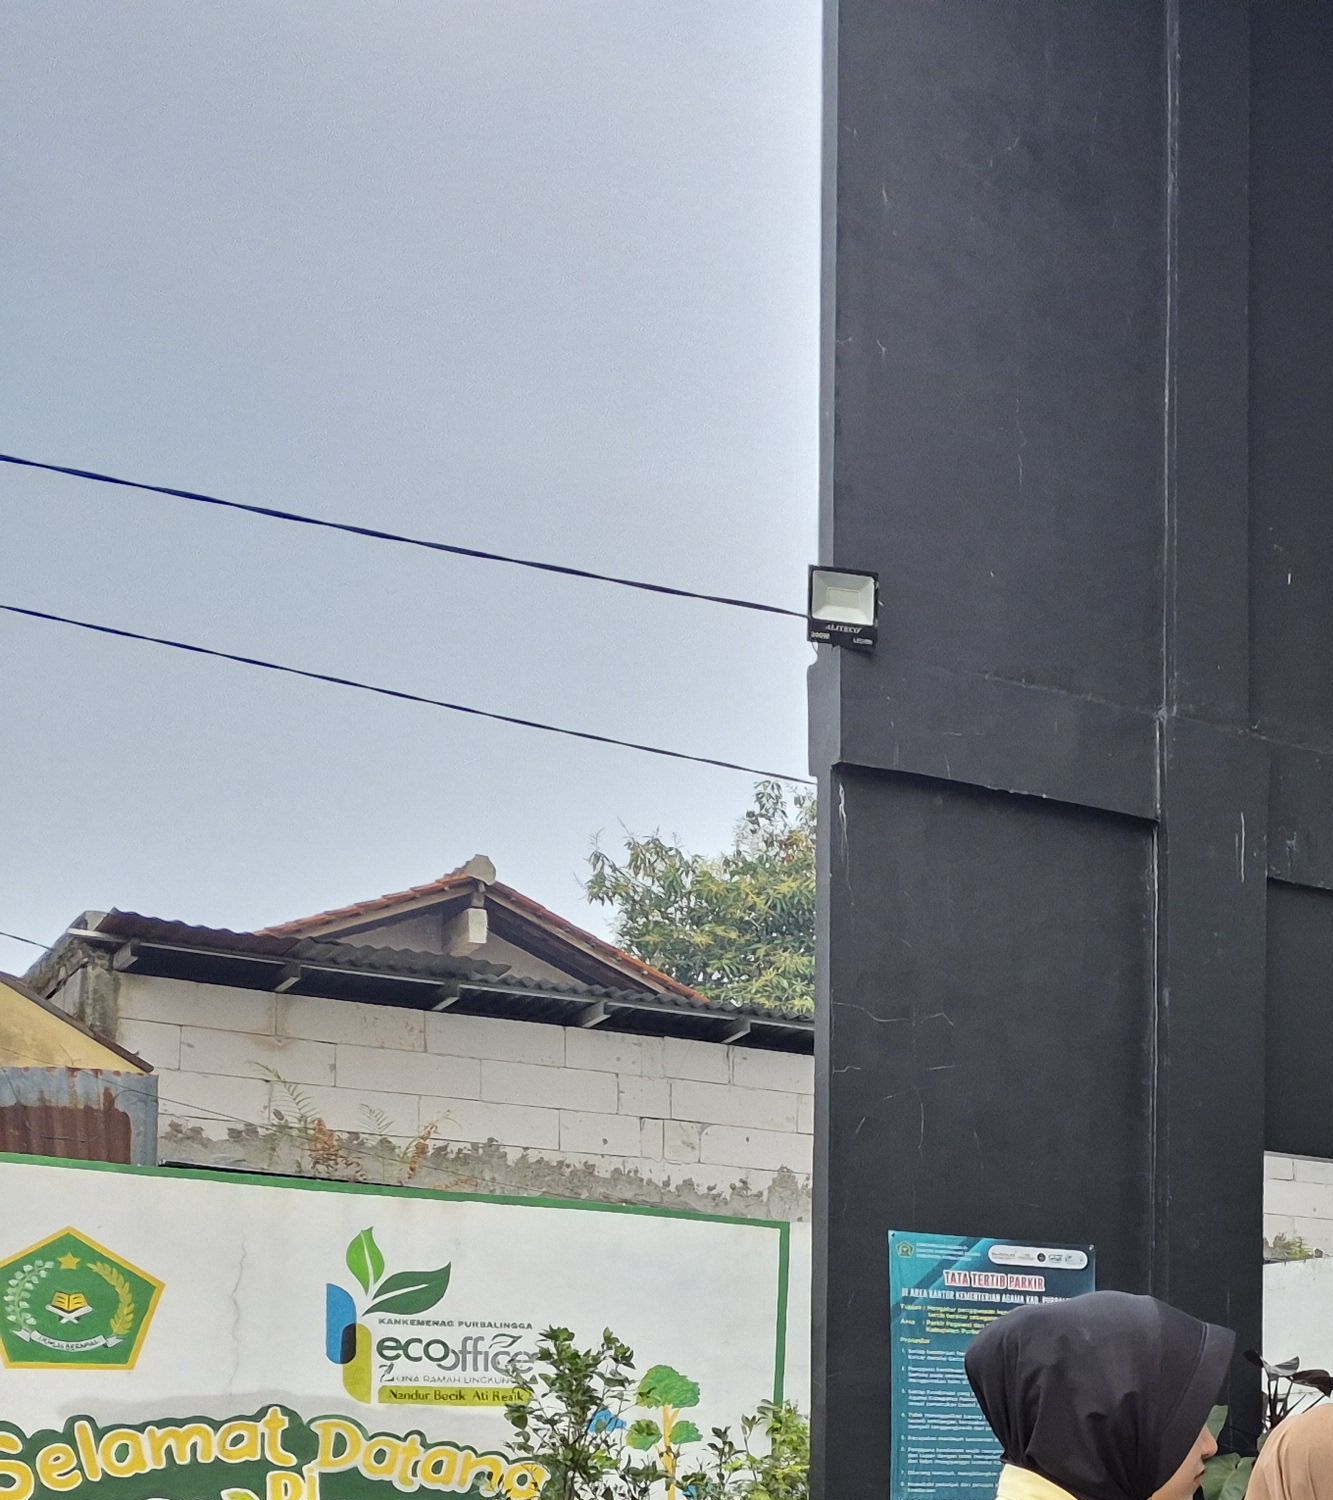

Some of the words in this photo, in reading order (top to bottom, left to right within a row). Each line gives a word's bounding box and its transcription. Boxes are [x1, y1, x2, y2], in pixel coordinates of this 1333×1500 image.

[944, 1271, 970, 1286] TATA
[971, 1273, 1006, 1288] TERTIB
[1008, 1275, 1045, 1290] PARKIR
[956, 1291, 1001, 1302] KEMENTERIAN
[378, 1317, 454, 1327] KANKEMENAG
[457, 1320, 533, 1330] PURBALINGGA
[423, 1375, 461, 1383] RAMAH
[388, 1389, 430, 1401] Nandur
[472, 1390, 489, 1401] Ati
[492, 1391, 524, 1402] Resik
